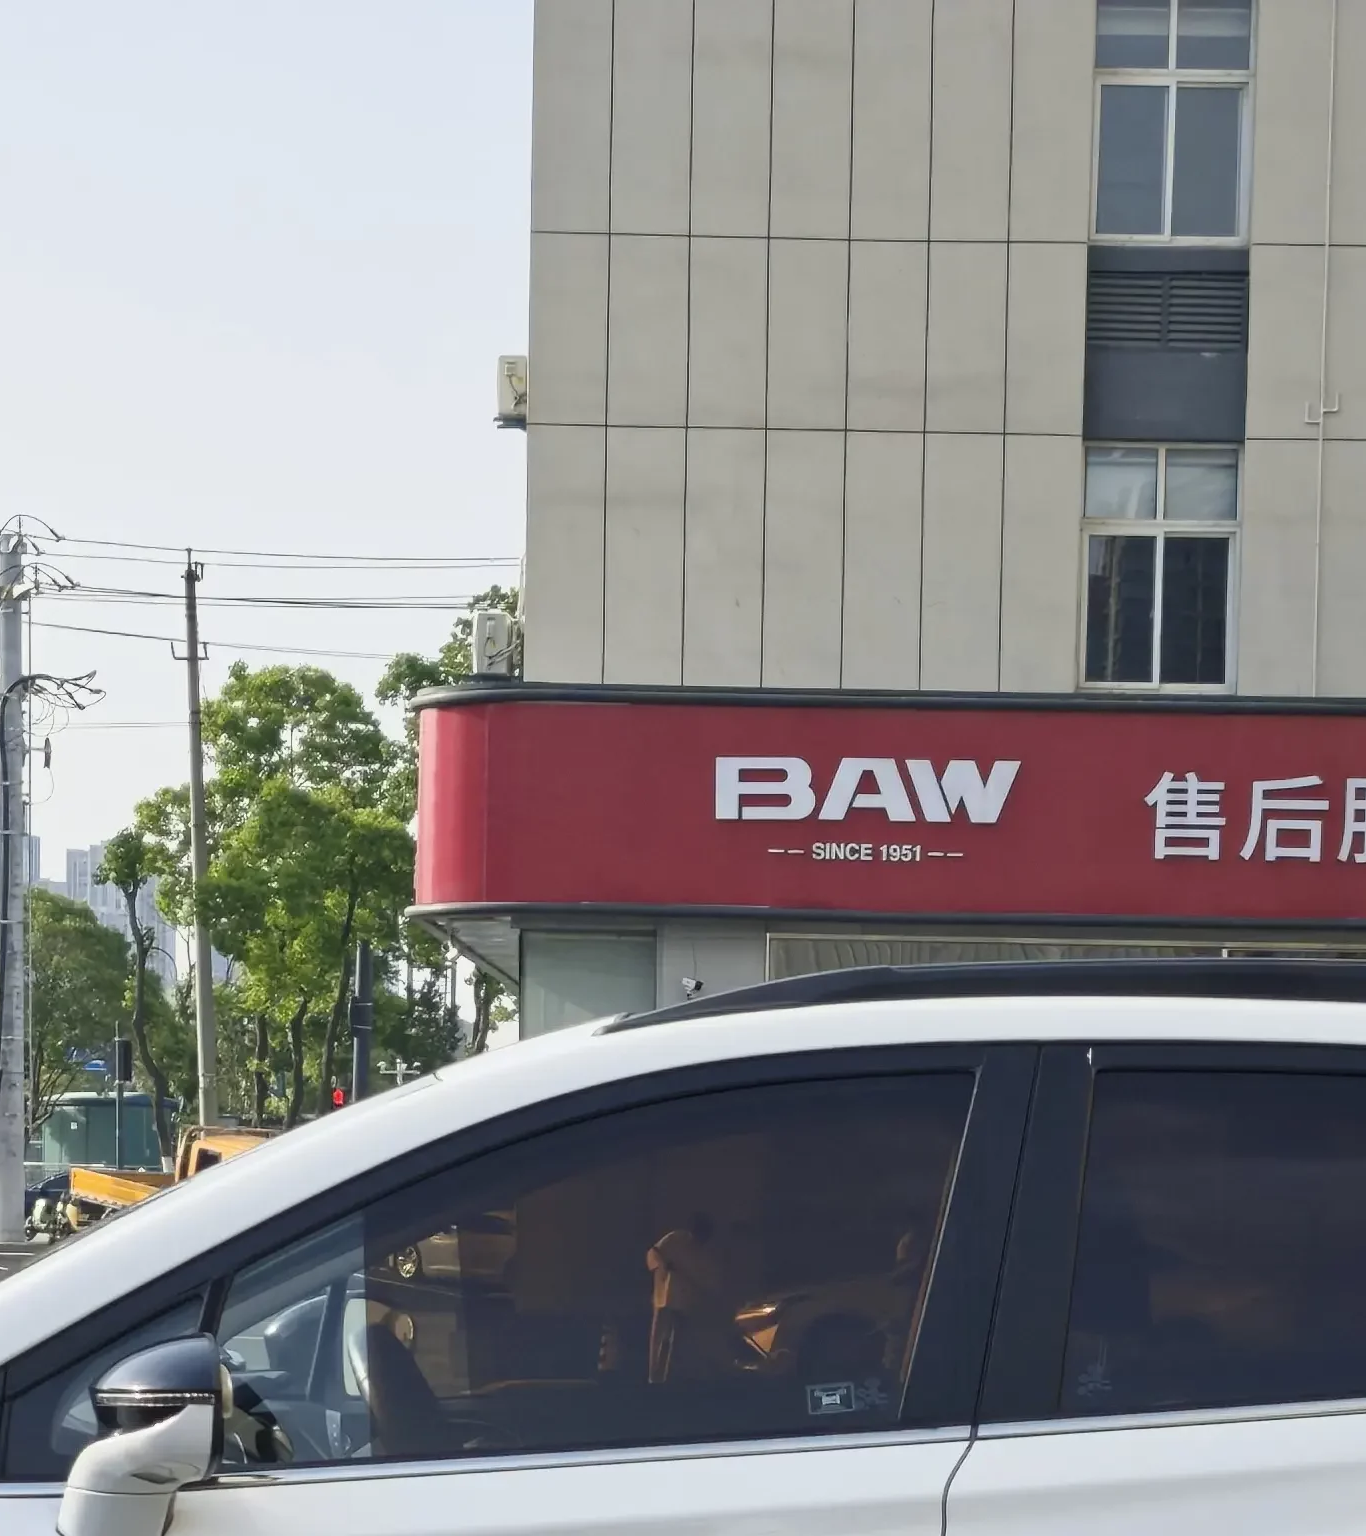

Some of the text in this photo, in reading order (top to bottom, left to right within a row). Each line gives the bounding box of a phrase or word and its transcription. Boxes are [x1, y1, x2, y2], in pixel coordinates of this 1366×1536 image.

[715, 756, 1022, 823] BAW
[811, 842, 922, 862] SINCE 1951
